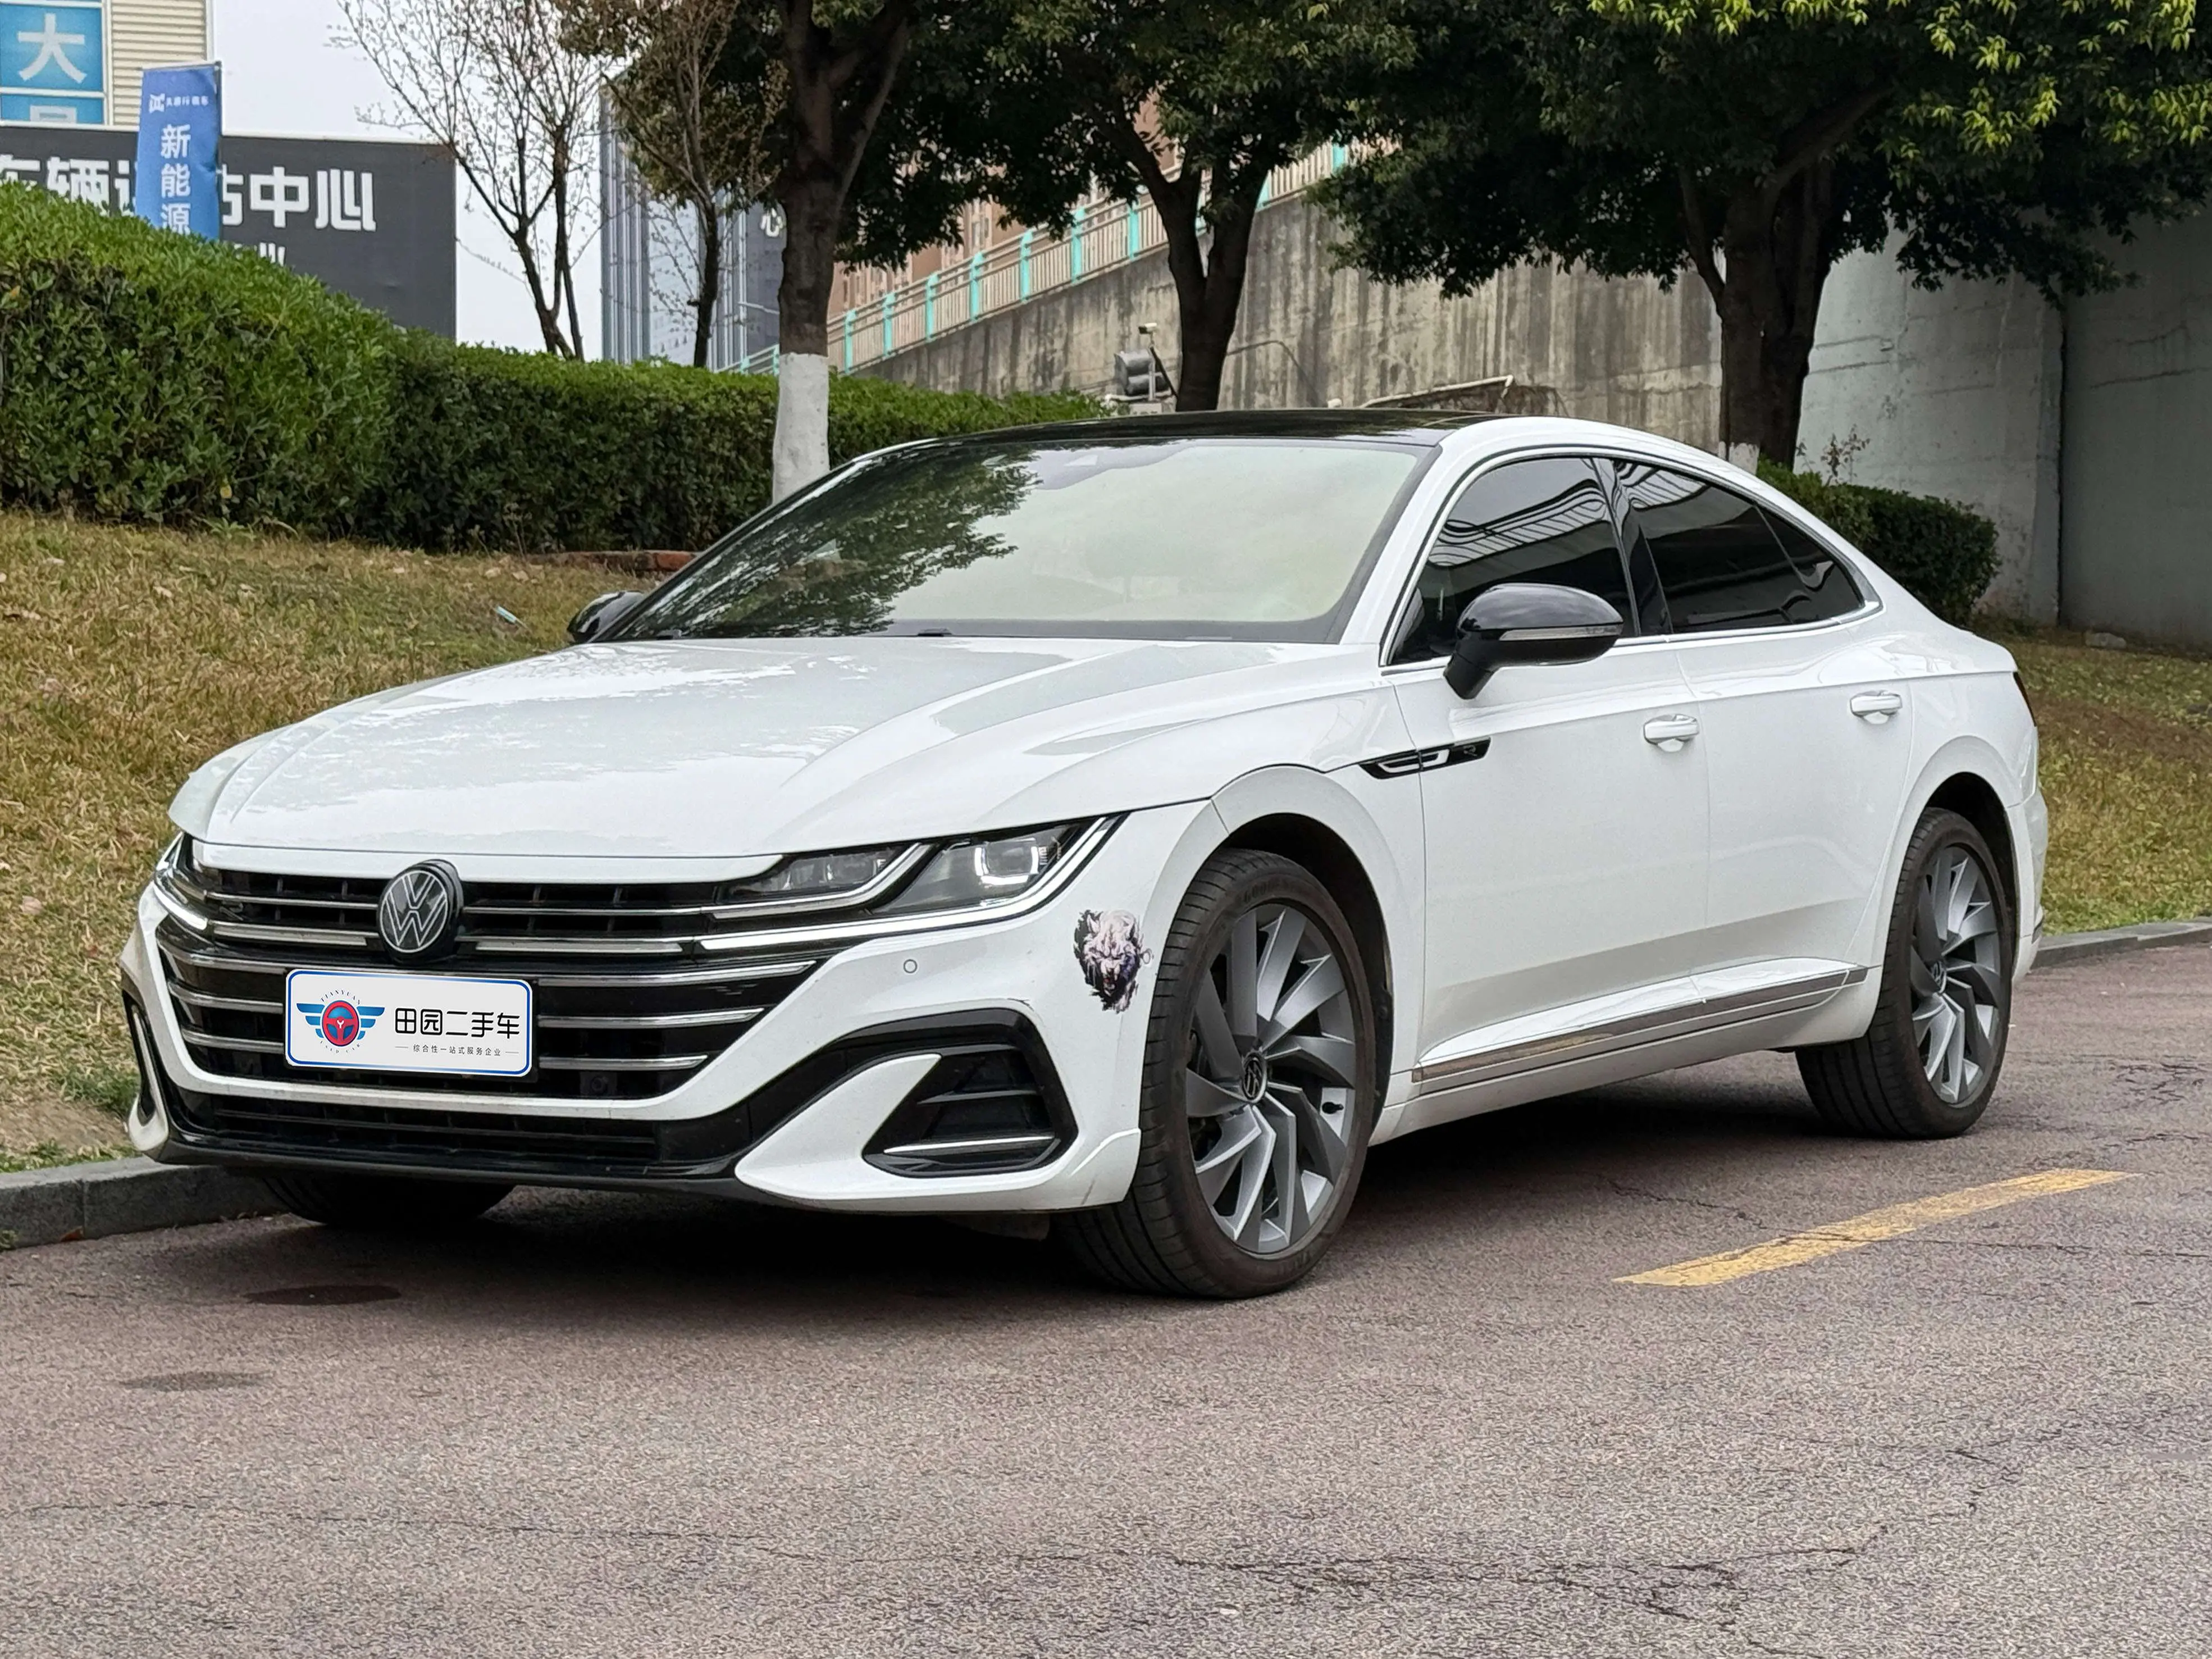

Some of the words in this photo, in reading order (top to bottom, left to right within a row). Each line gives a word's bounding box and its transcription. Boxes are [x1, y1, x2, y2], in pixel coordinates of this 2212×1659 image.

[0, 154, 376, 231] 辆中心
[161, 124, 191, 235] 新能源
[395, 1008, 520, 1039] 田园二手车
[413, 1043, 501, 1056] 综合性一站式服务企业
